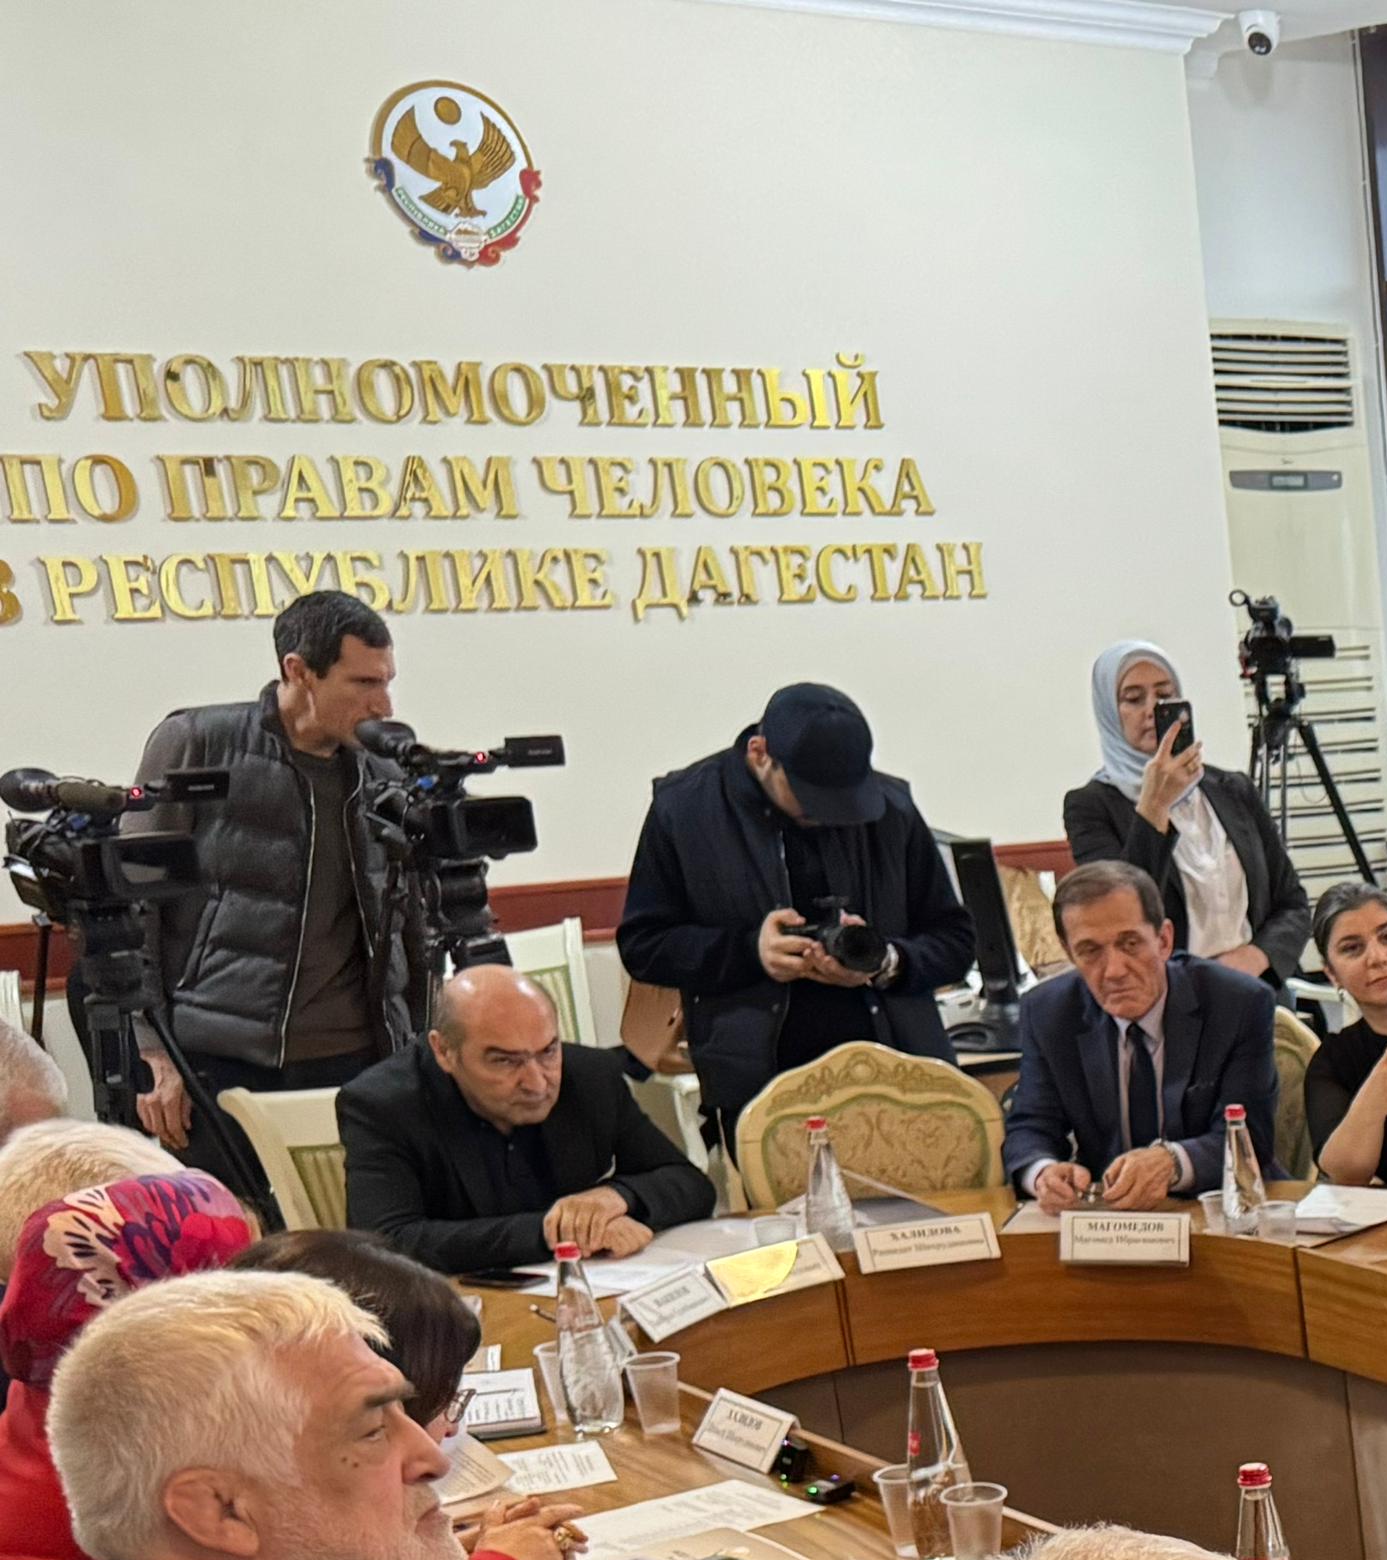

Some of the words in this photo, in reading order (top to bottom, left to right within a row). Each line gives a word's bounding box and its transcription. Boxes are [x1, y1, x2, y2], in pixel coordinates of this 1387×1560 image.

[24, 350, 885, 430] УПОЛНОМОЧЕННЫЙ
[0, 453, 139, 523] ПО
[156, 454, 519, 521] ПРАВАМ
[532, 455, 937, 520] ЧЕЛОВЕКА
[38, 546, 615, 623] РЕСПУБЛИКЕ
[632, 540, 989, 623] ДАГЕСТАН
